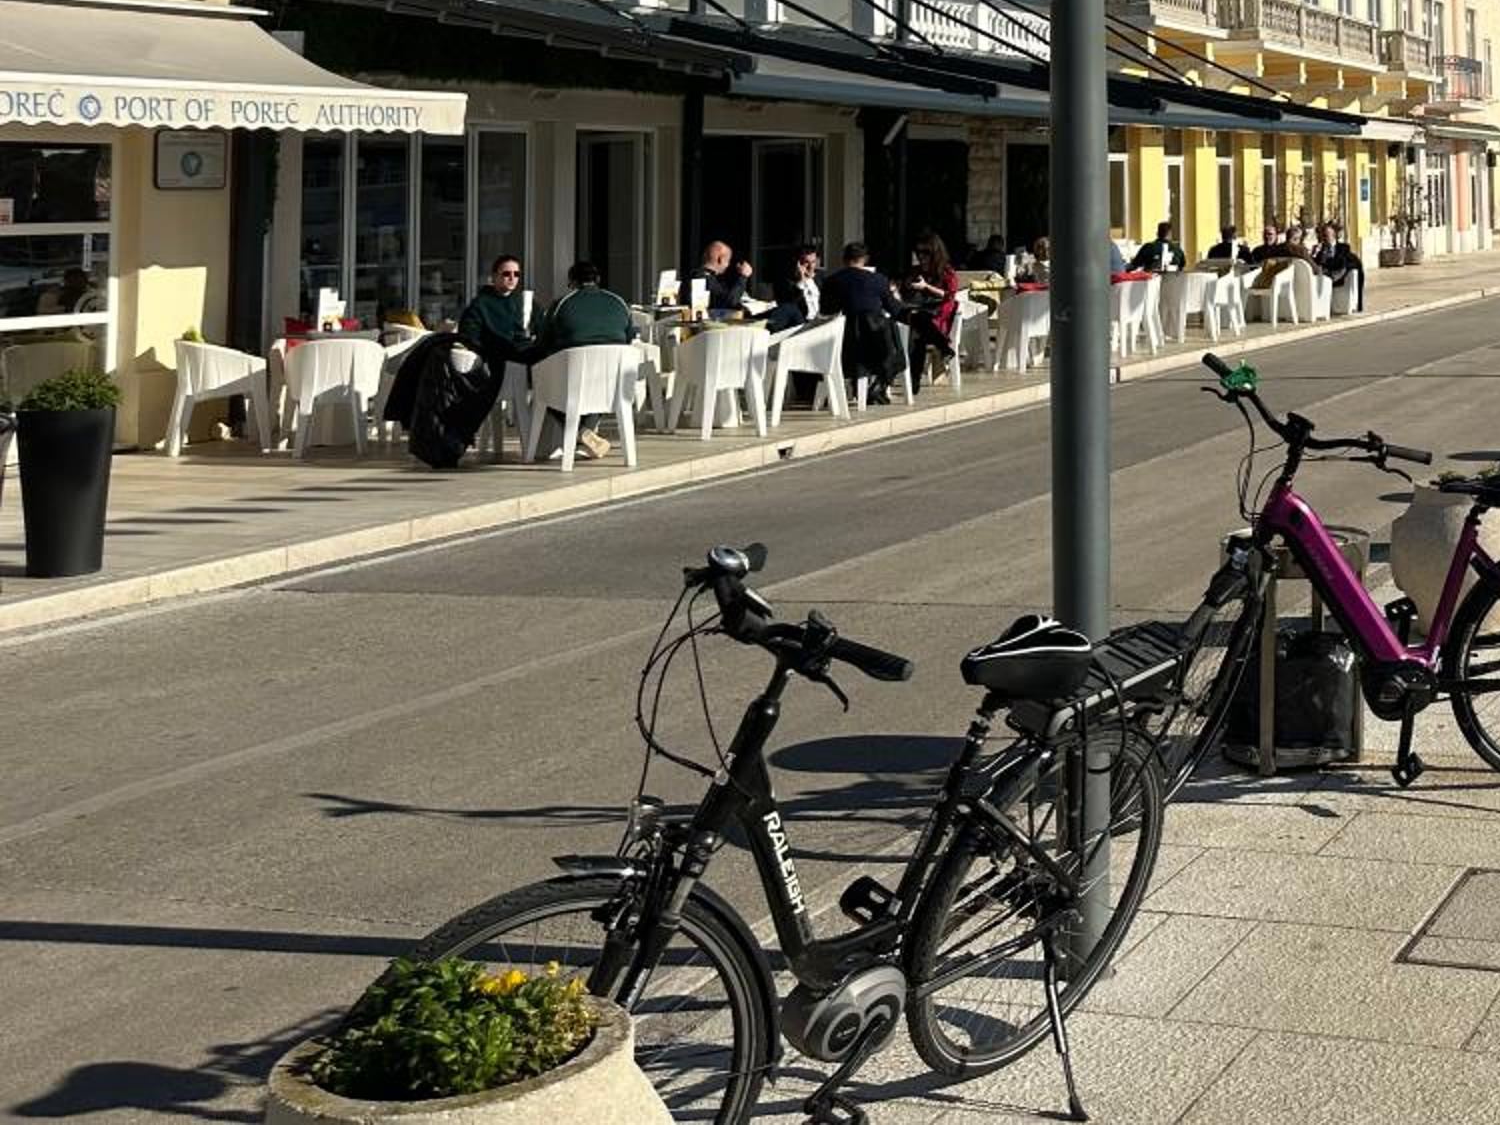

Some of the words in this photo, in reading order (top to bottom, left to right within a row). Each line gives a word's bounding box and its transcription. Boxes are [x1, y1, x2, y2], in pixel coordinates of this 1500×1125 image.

[114, 96, 177, 121] PORT
[185, 98, 216, 122] OF
[231, 98, 299, 124] POREČ
[315, 103, 423, 127] AUTHORITY
[763, 810, 805, 915] RALEIGH
